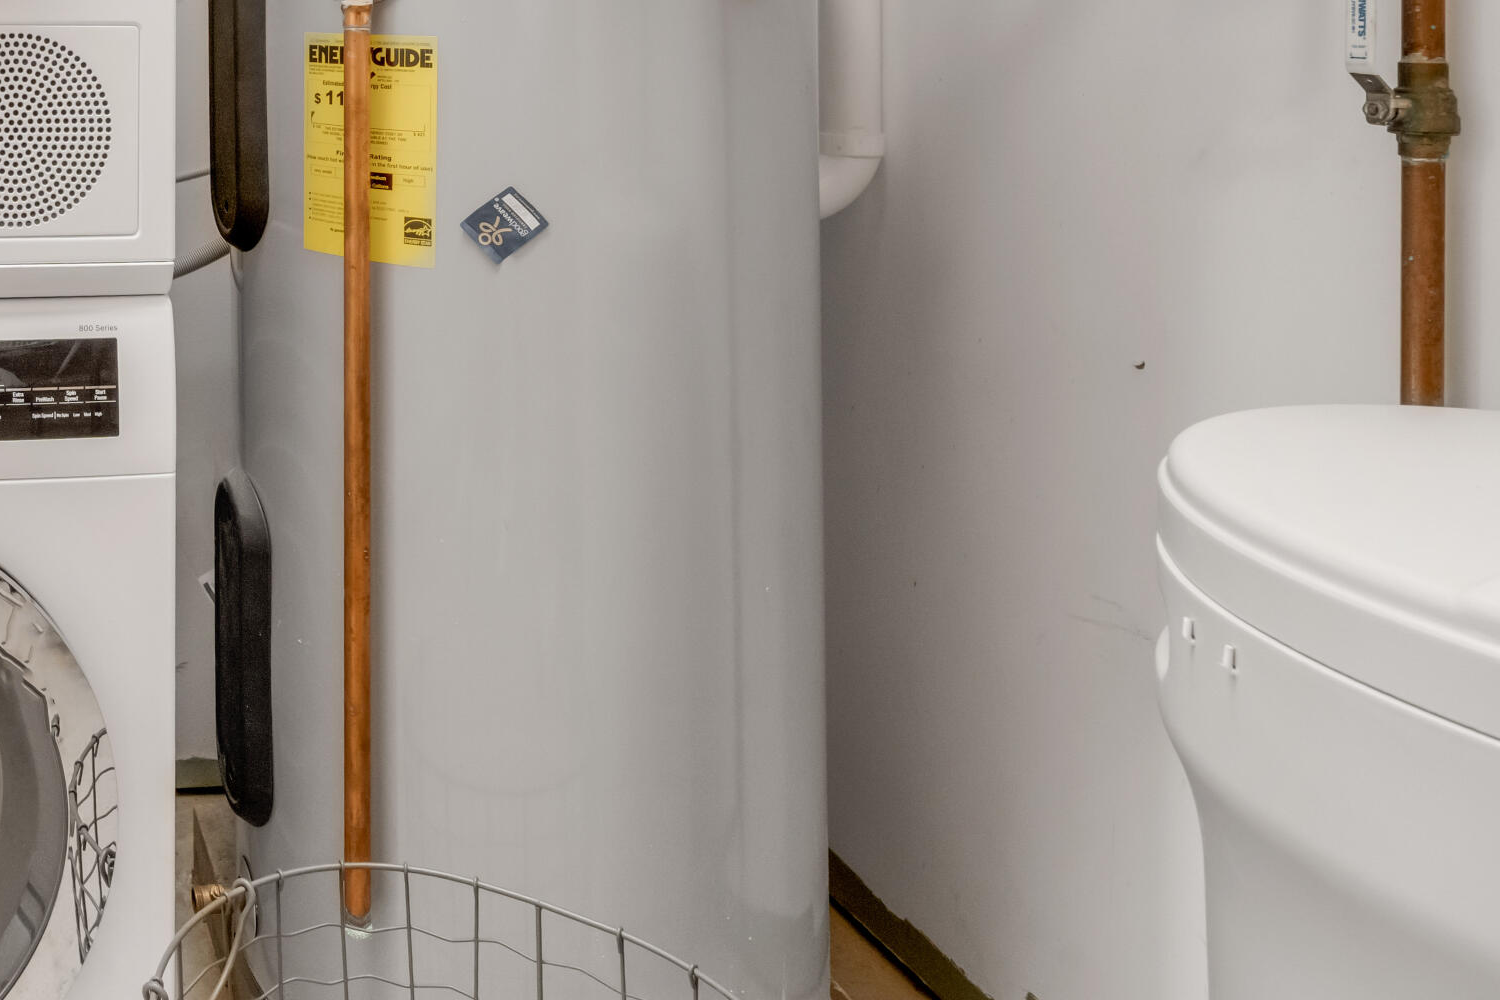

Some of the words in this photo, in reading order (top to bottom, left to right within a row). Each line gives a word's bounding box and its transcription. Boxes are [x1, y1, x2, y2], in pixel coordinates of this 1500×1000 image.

[309, 45, 433, 68] ENEGUIDE
[314, 93, 321, 104] $
[369, 154, 392, 162] Rating
[493, 202, 529, 238] goodweave
[96, 324, 118, 332] Series
